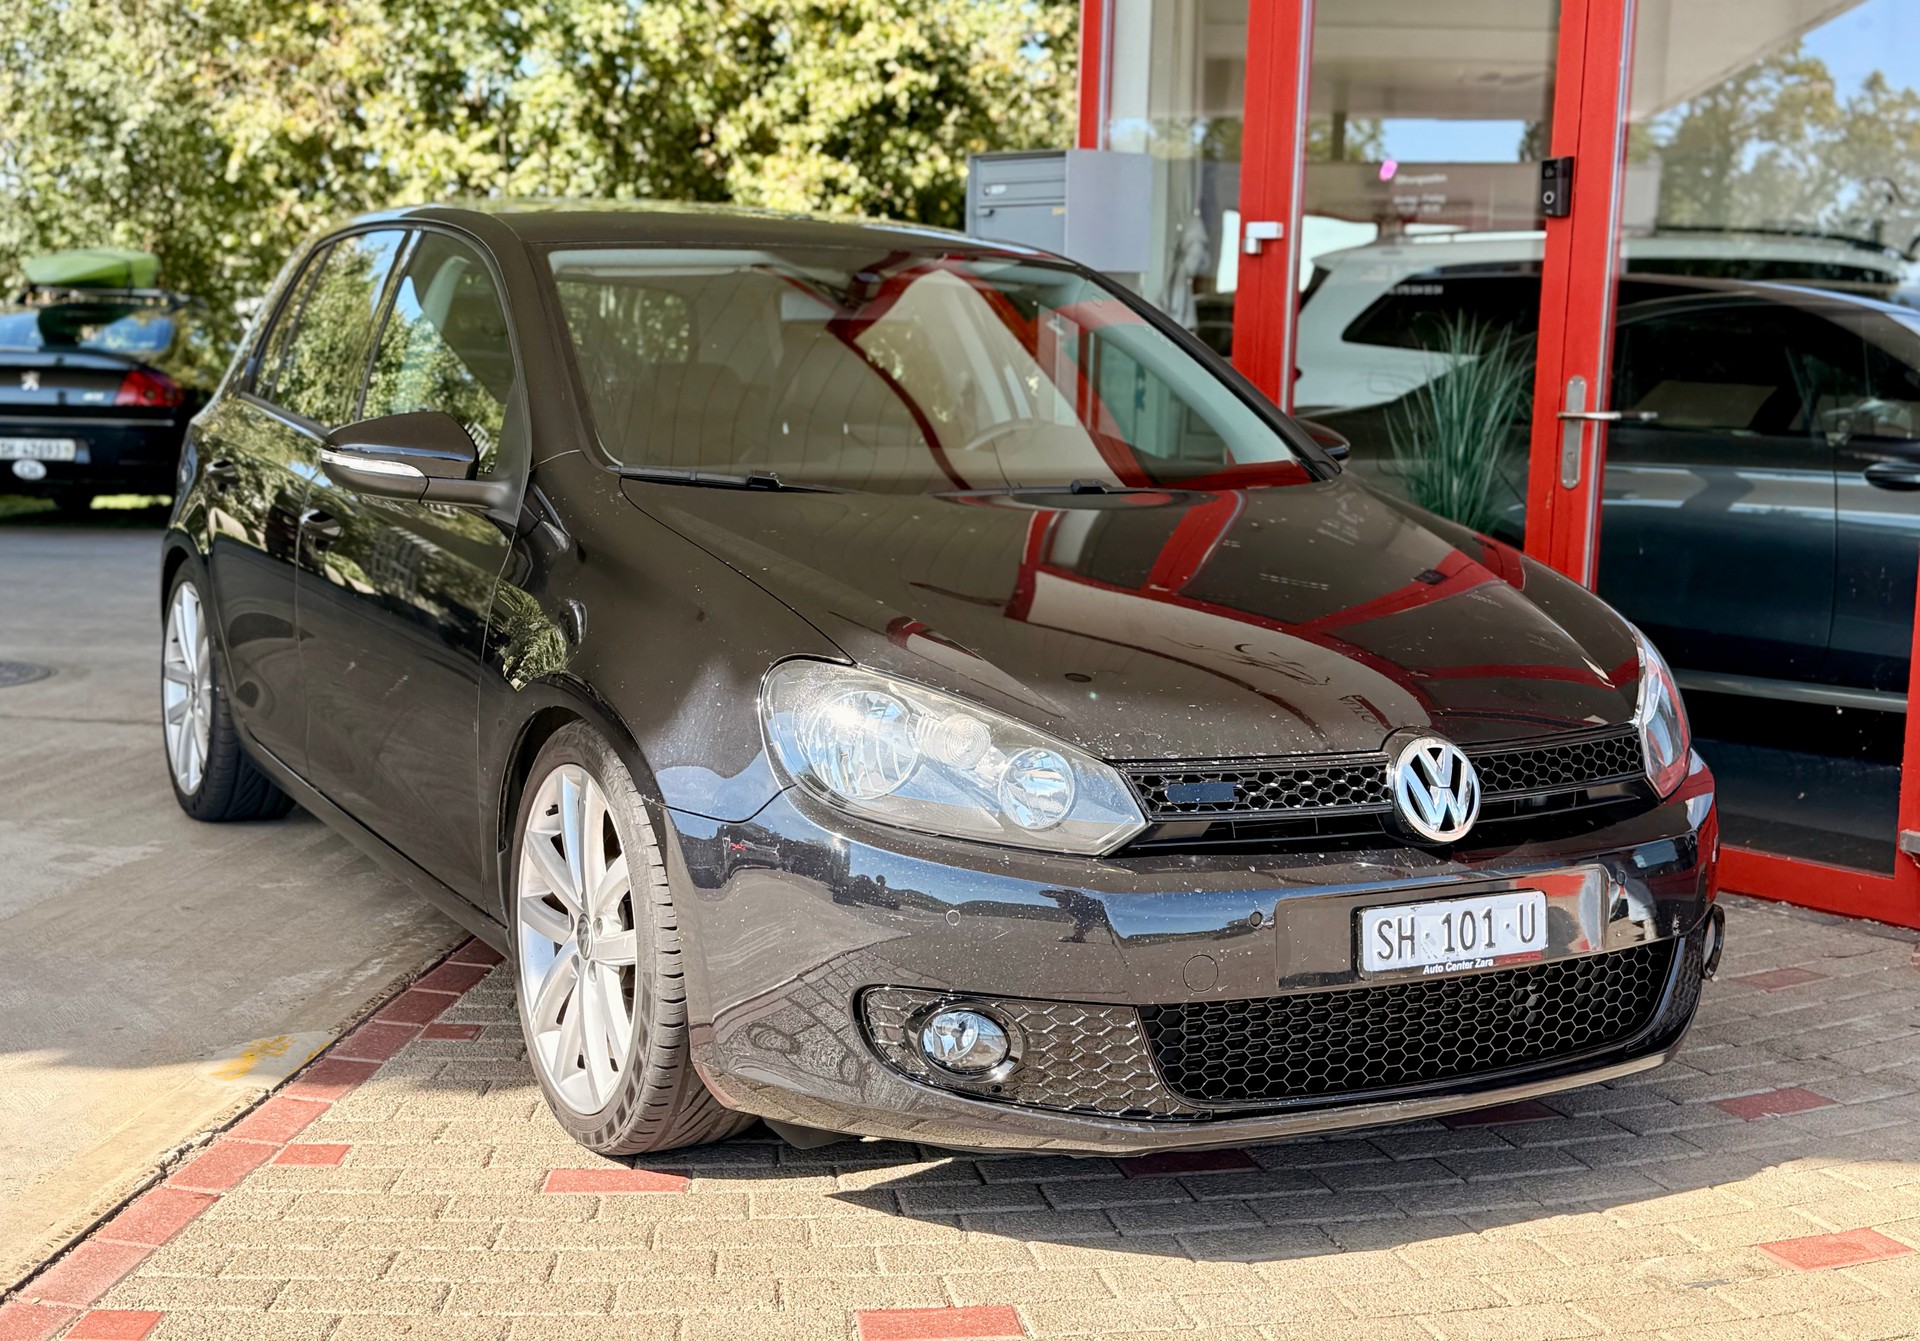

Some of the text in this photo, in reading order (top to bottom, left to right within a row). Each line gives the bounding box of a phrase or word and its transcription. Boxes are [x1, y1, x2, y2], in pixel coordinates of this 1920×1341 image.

[1377, 902, 1536, 960] SH 101 U
[1423, 958, 1494, 975] Auto Center Zara
